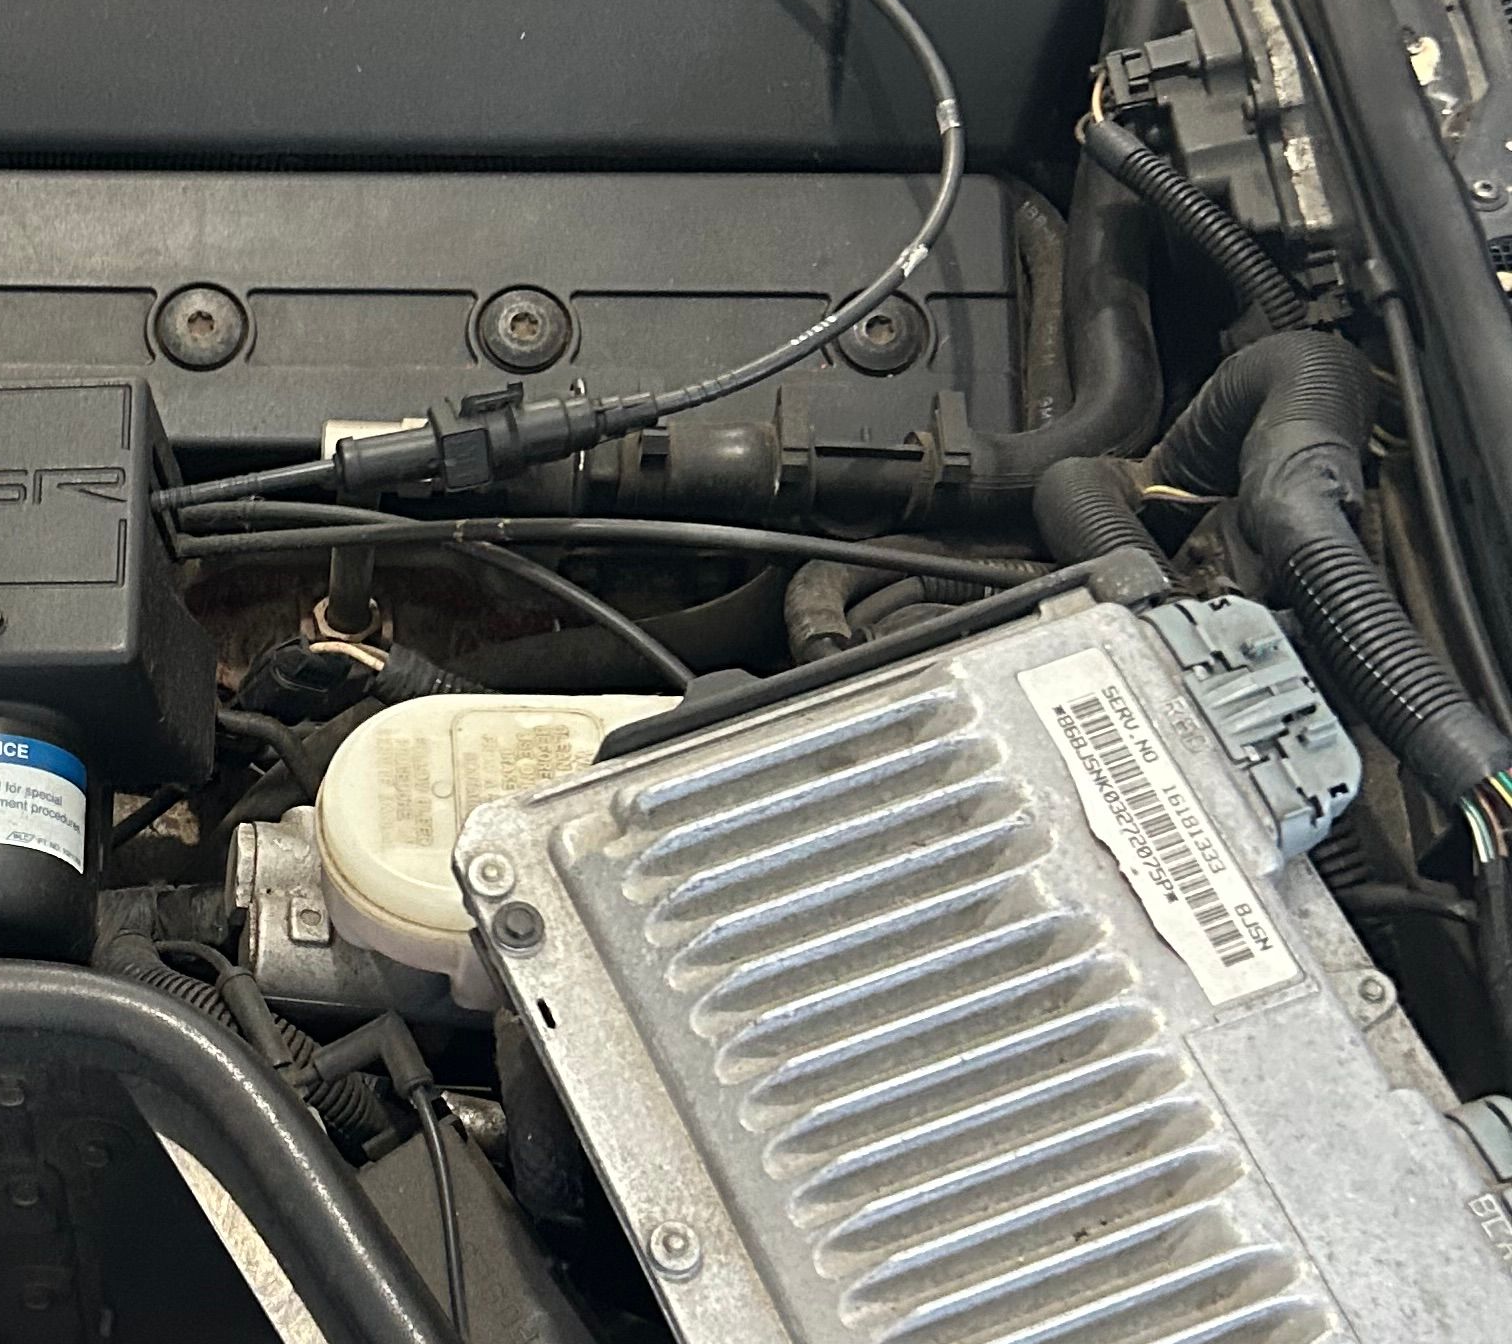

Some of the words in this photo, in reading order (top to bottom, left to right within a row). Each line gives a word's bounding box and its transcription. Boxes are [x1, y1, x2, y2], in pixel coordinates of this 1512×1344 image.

[5, 781, 22, 794] for
[24, 786, 63, 806] special
[1100, 682, 1159, 765] SERV.NO
[1161, 783, 1226, 876] 16181333
